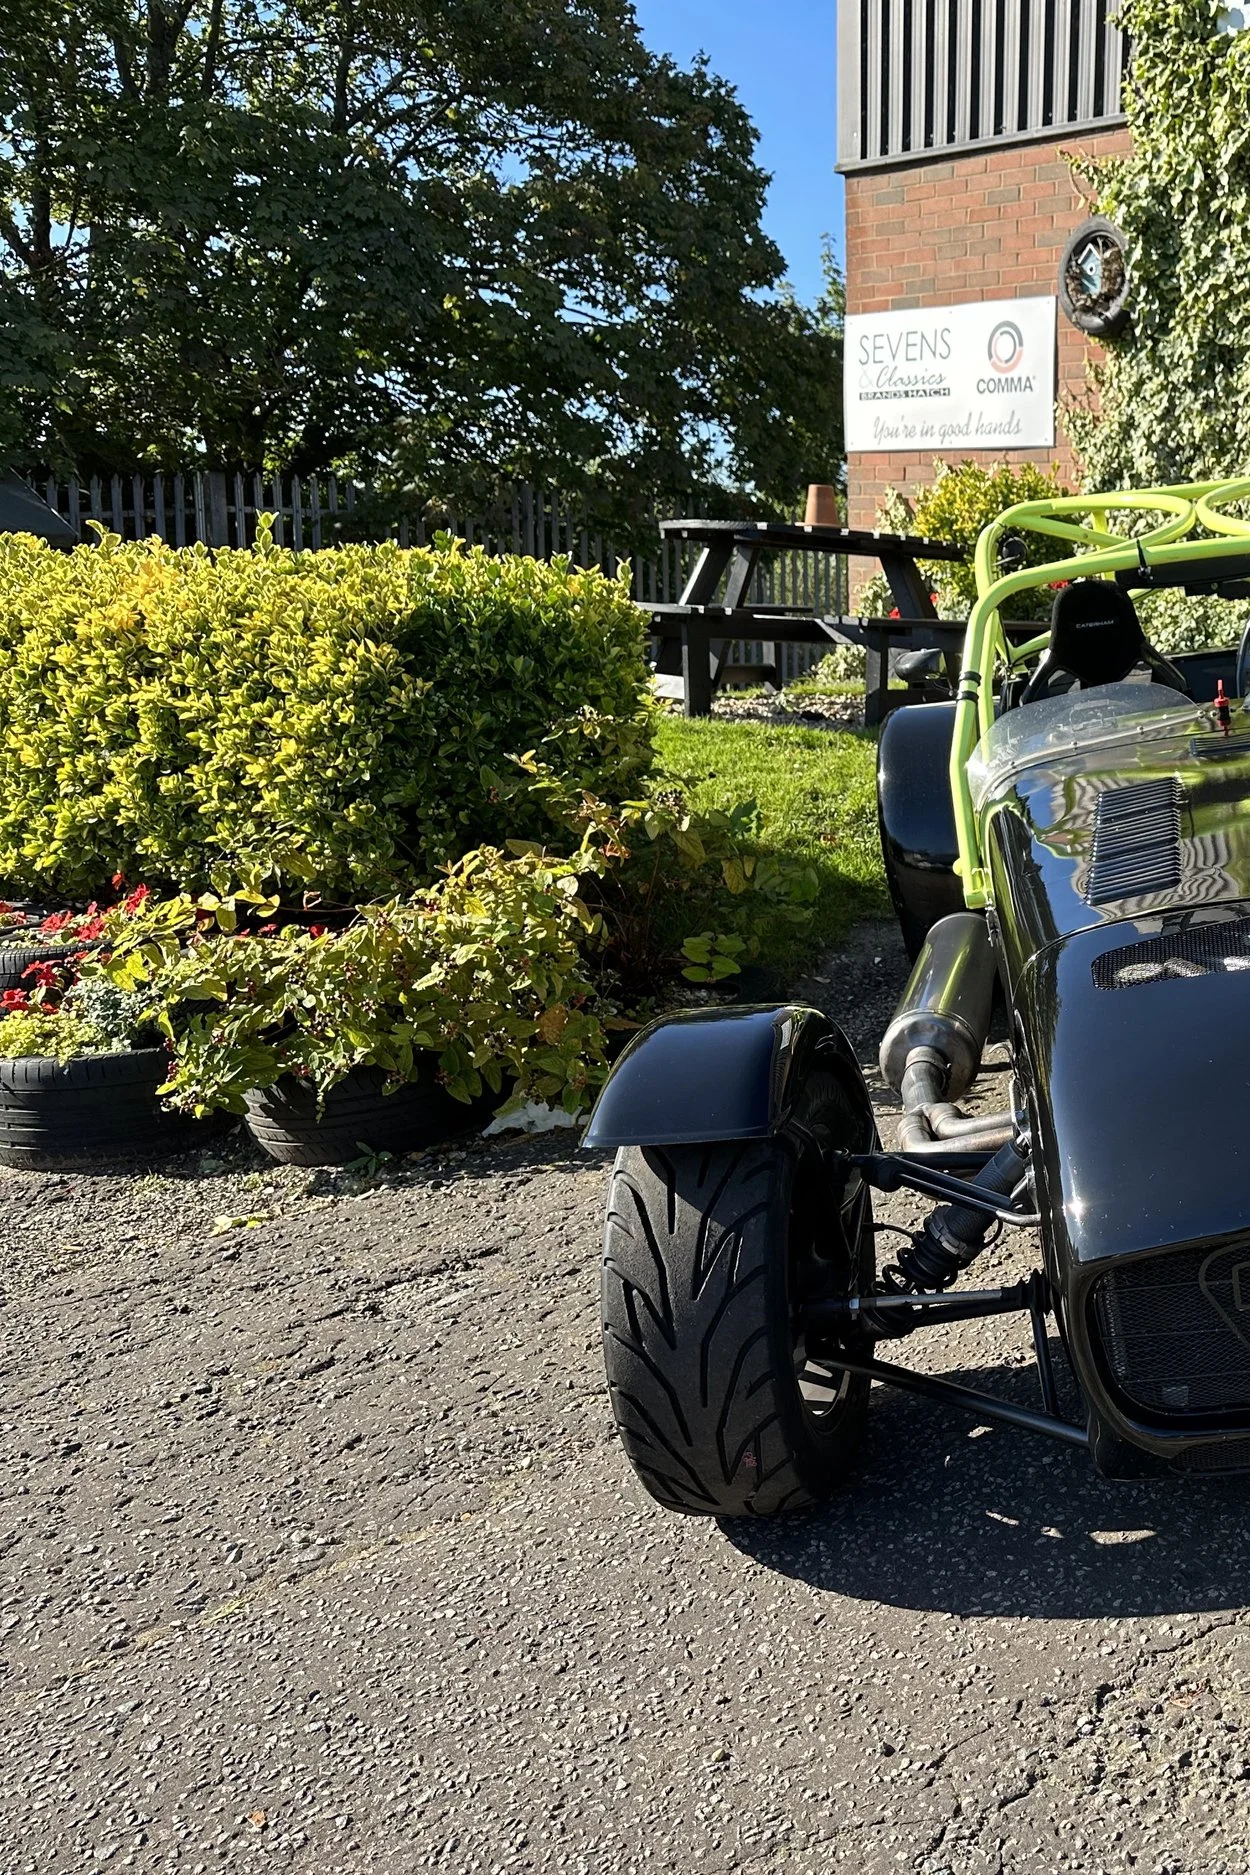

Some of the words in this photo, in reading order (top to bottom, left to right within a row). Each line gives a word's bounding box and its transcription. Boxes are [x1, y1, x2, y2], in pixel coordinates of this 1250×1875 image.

[859, 328, 951, 365] SEVENS
[876, 365, 946, 388] Classics
[861, 390, 905, 400] BRANDS
[909, 388, 949, 398] HATCH
[874, 415, 917, 445] You're
[920, 420, 935, 438] in
[938, 411, 971, 445] good
[975, 410, 1022, 436] hands
[1076, 619, 1114, 629] CATERHAM
